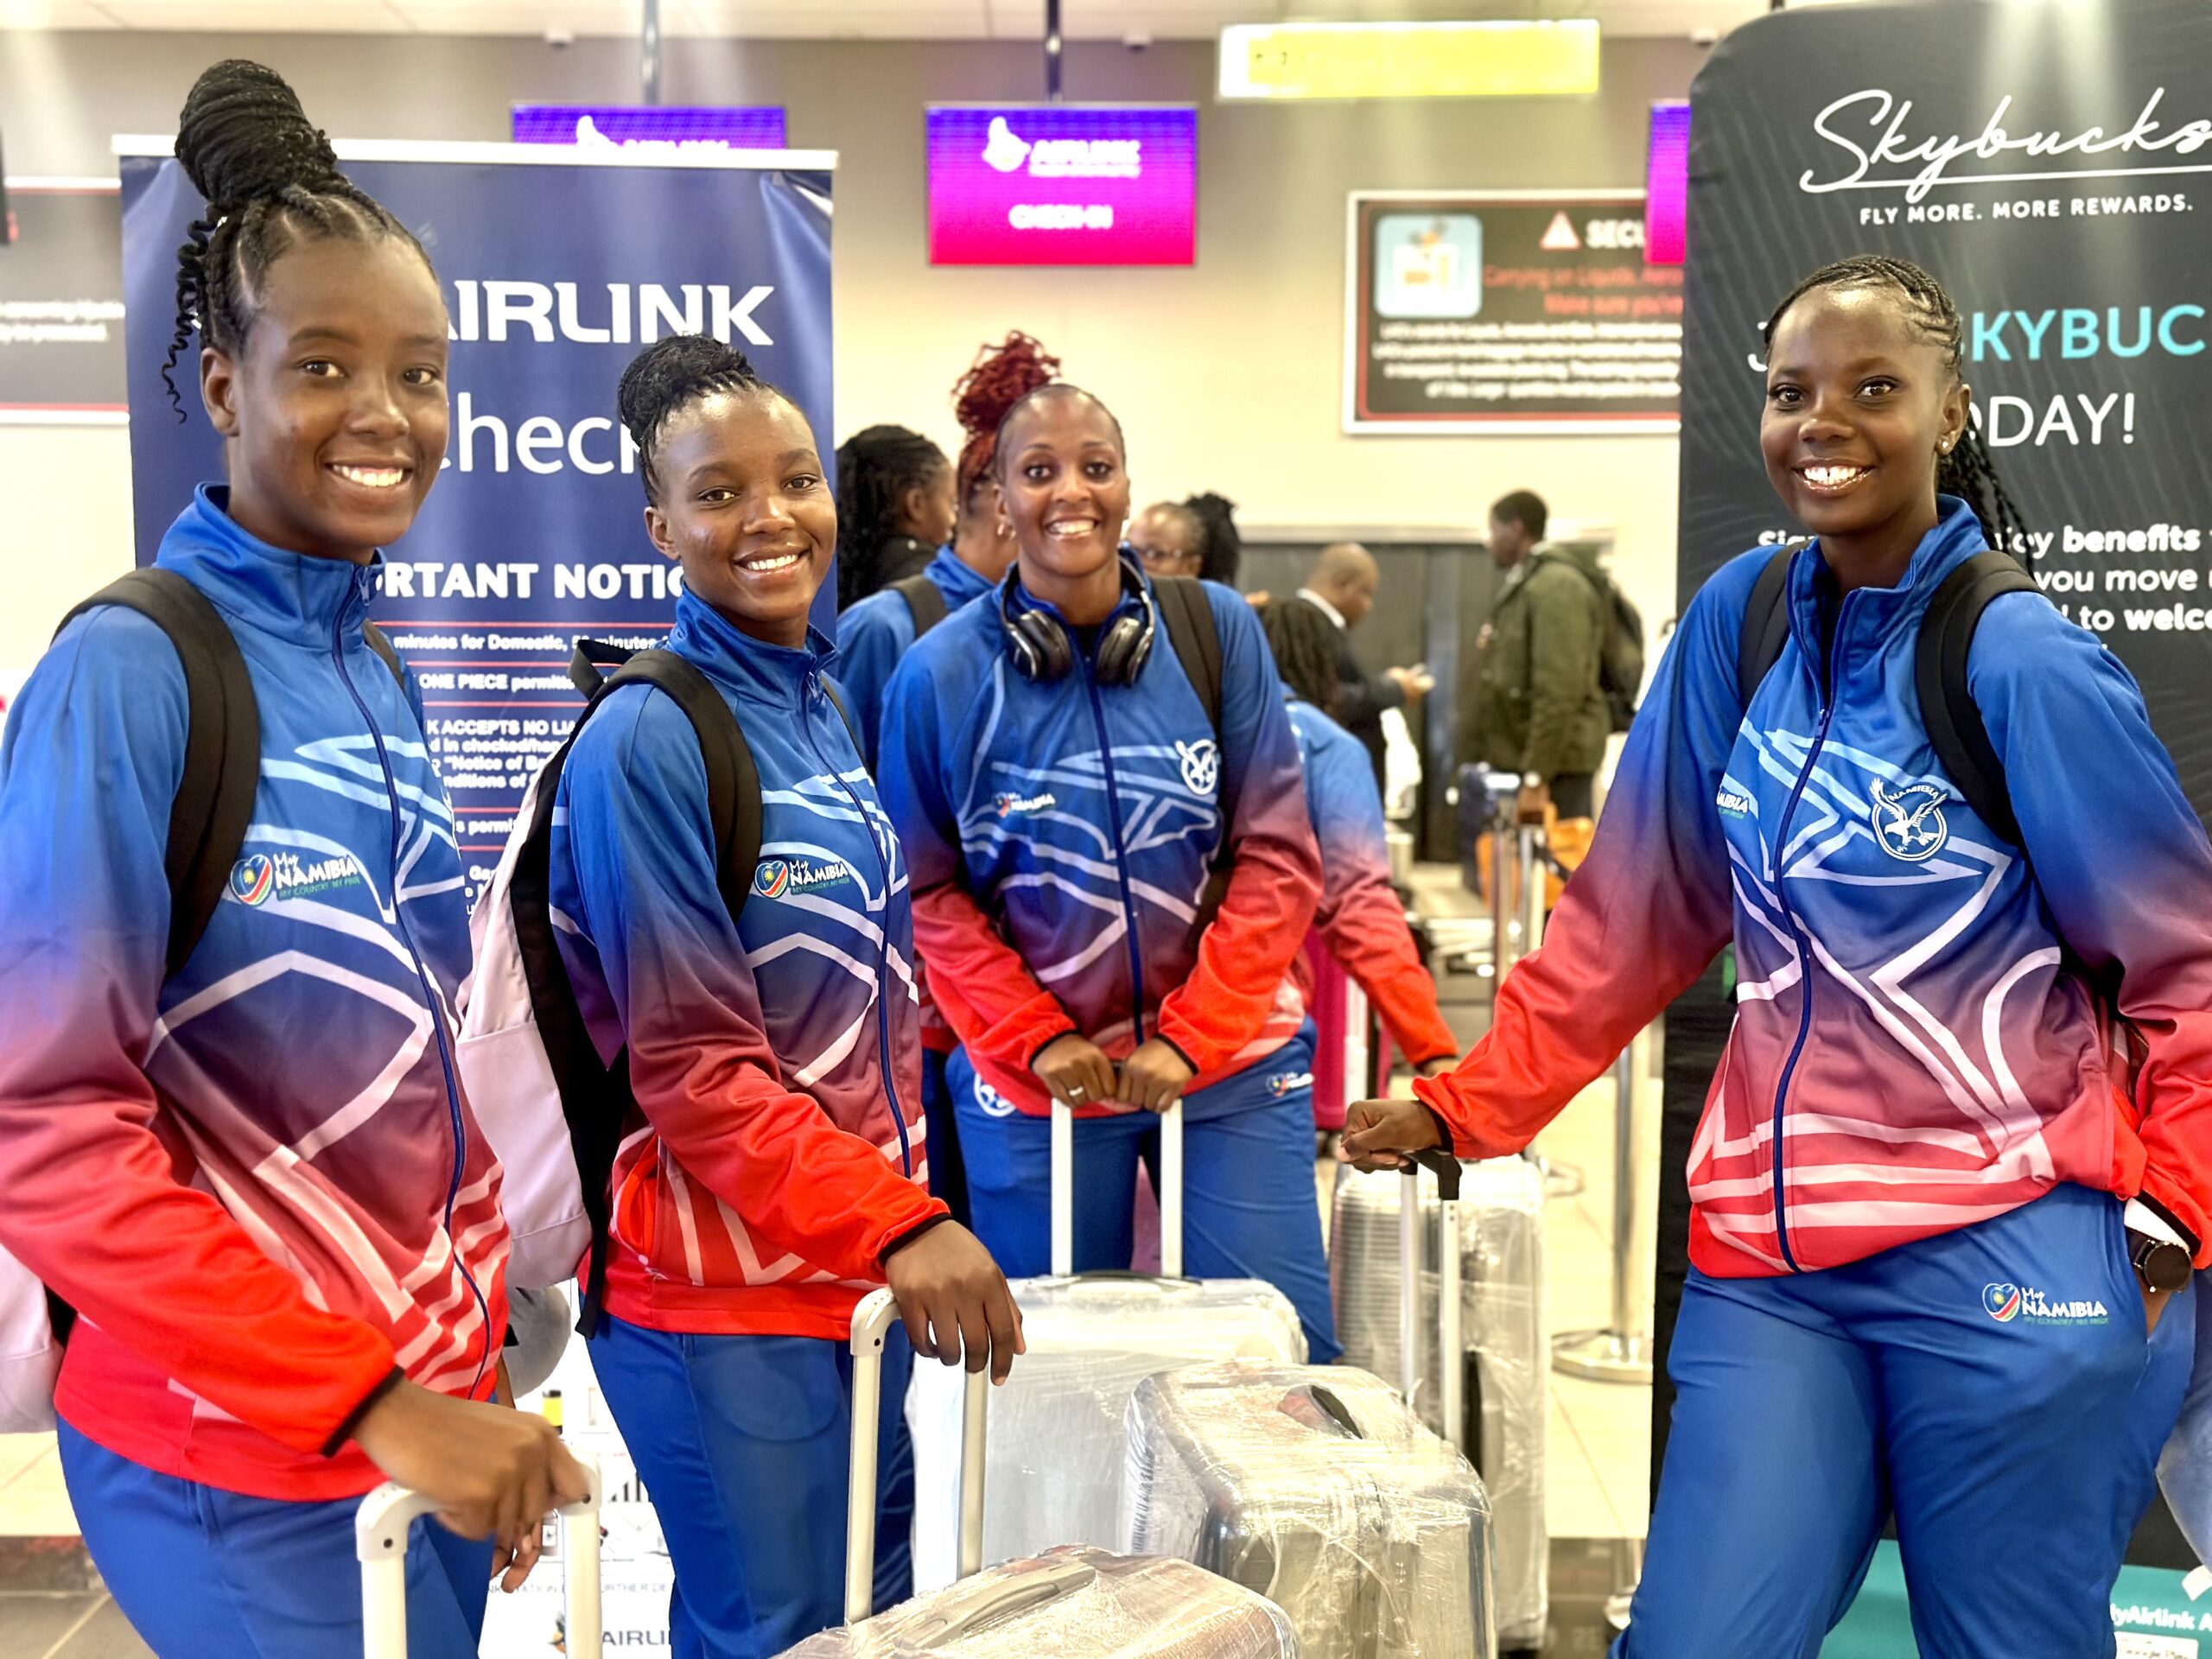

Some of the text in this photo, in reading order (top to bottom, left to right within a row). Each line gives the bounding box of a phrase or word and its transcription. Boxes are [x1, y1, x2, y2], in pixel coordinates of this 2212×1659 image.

[1800, 87, 2212, 203] Skybucks
[1859, 194, 2193, 226] FLY MORE. MORE REWARDS.
[448, 280, 774, 346] IRLINK
[1961, 304, 2206, 362] KYBUC
[1970, 392, 2135, 447] DAY!
[439, 391, 640, 474] hec
[2063, 524, 2202, 553] benefits
[376, 562, 538, 599] RTANT
[2105, 569, 2198, 592] move
[2079, 606, 2115, 632] to
[393, 632, 458, 650] minutes
[461, 633, 485, 650] for
[419, 674, 455, 690] ONE
[458, 674, 509, 690] PIECE
[442, 720, 520, 735] ACCEPTS
[523, 720, 550, 735] NO
[1888, 785, 1939, 801] NAMIBIA
[273, 852, 299, 872] My
[275, 857, 358, 889] NAMIBIA
[789, 859, 809, 874] My
[790, 862, 849, 887] NAMIBIA
[2021, 1287, 2045, 1306] My
[2021, 1300, 2108, 1318] NAMIBIA
[601, 1630, 671, 1646] AIRLI
